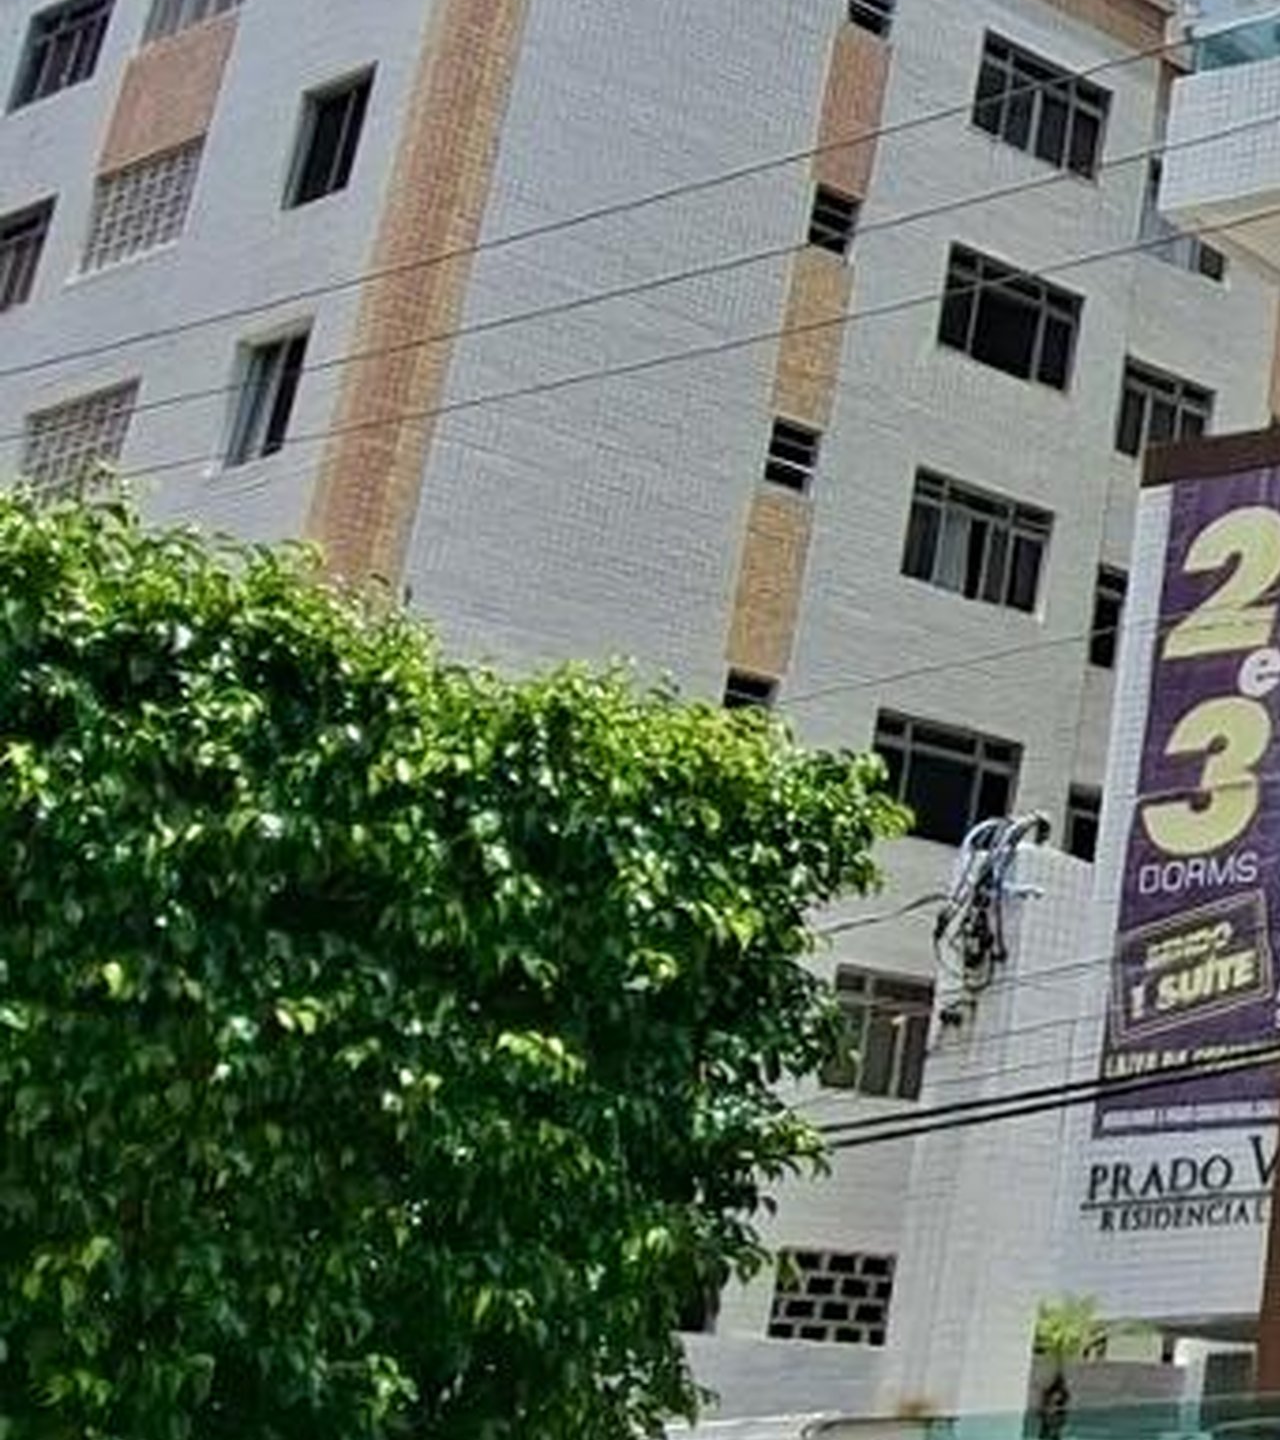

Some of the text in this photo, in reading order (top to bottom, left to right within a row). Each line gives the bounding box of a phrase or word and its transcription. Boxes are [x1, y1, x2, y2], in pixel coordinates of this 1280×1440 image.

[1142, 696, 1272, 857] 3
[1139, 851, 1259, 895] DORMS
[1088, 1154, 1234, 1201] PRADO
[1100, 1198, 1267, 1232] RESIDENCIAL
